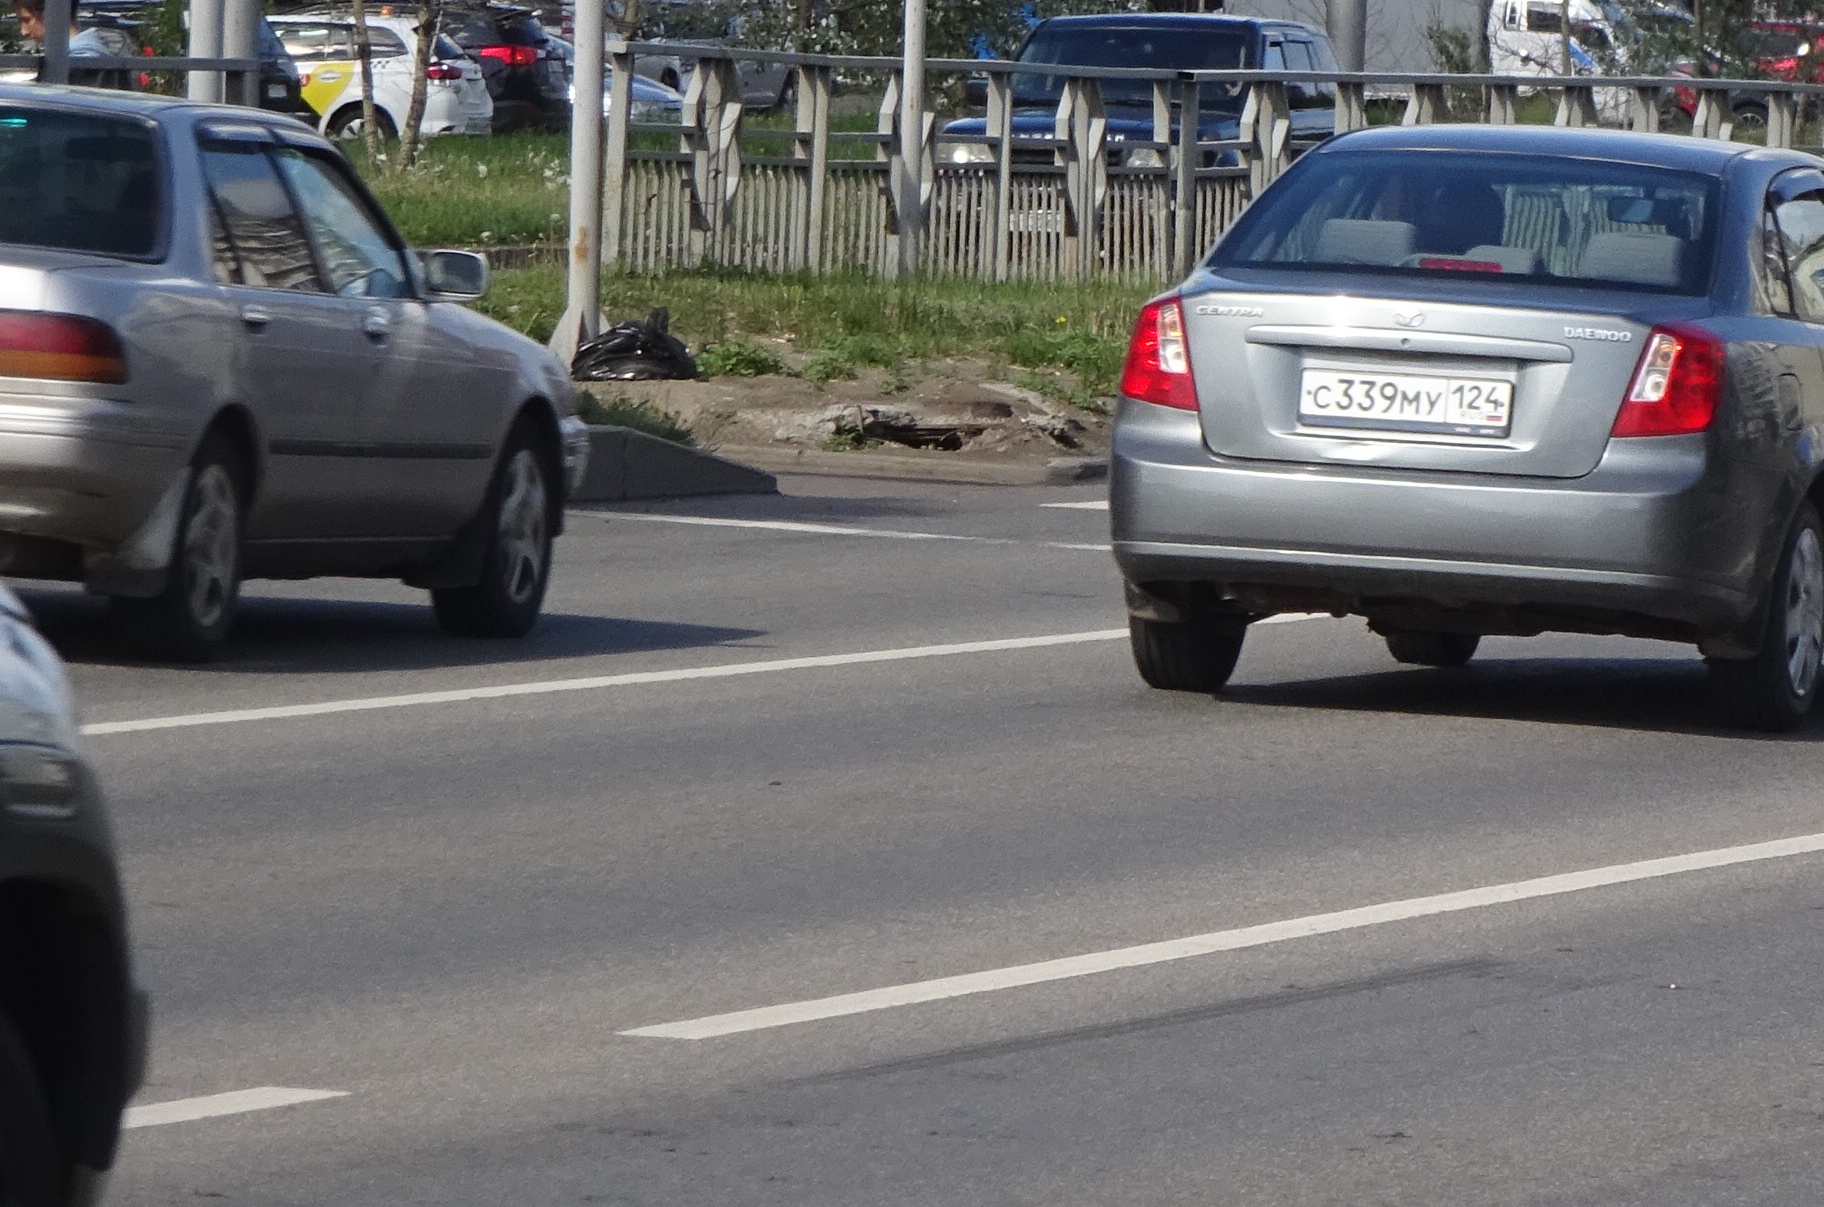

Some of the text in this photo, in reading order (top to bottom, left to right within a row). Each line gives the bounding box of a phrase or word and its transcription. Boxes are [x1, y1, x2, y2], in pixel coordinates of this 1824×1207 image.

[1564, 326, 1632, 342] DAEWOO
[1313, 379, 1505, 415] С339МУ 124
